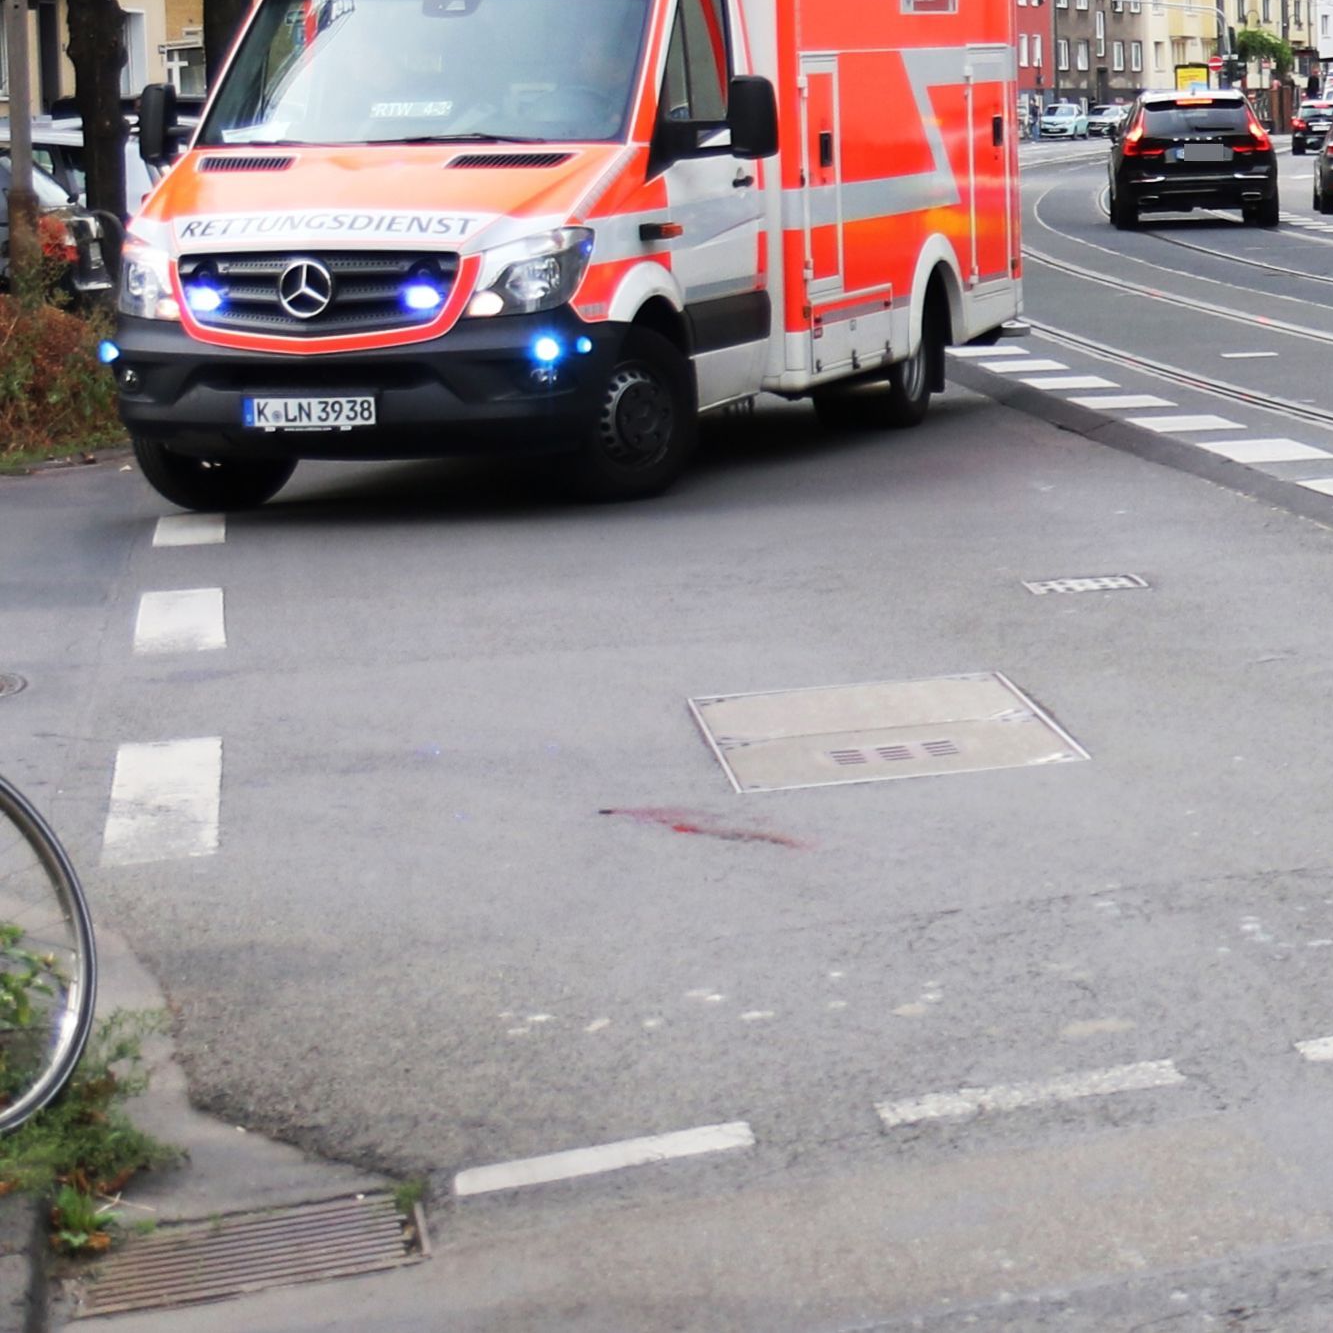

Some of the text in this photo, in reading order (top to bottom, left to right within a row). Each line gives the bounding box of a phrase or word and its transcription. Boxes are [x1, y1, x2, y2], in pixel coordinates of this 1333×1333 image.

[180, 213, 479, 239] RETTUNGSDIENST
[256, 399, 373, 423] K LN 3938
